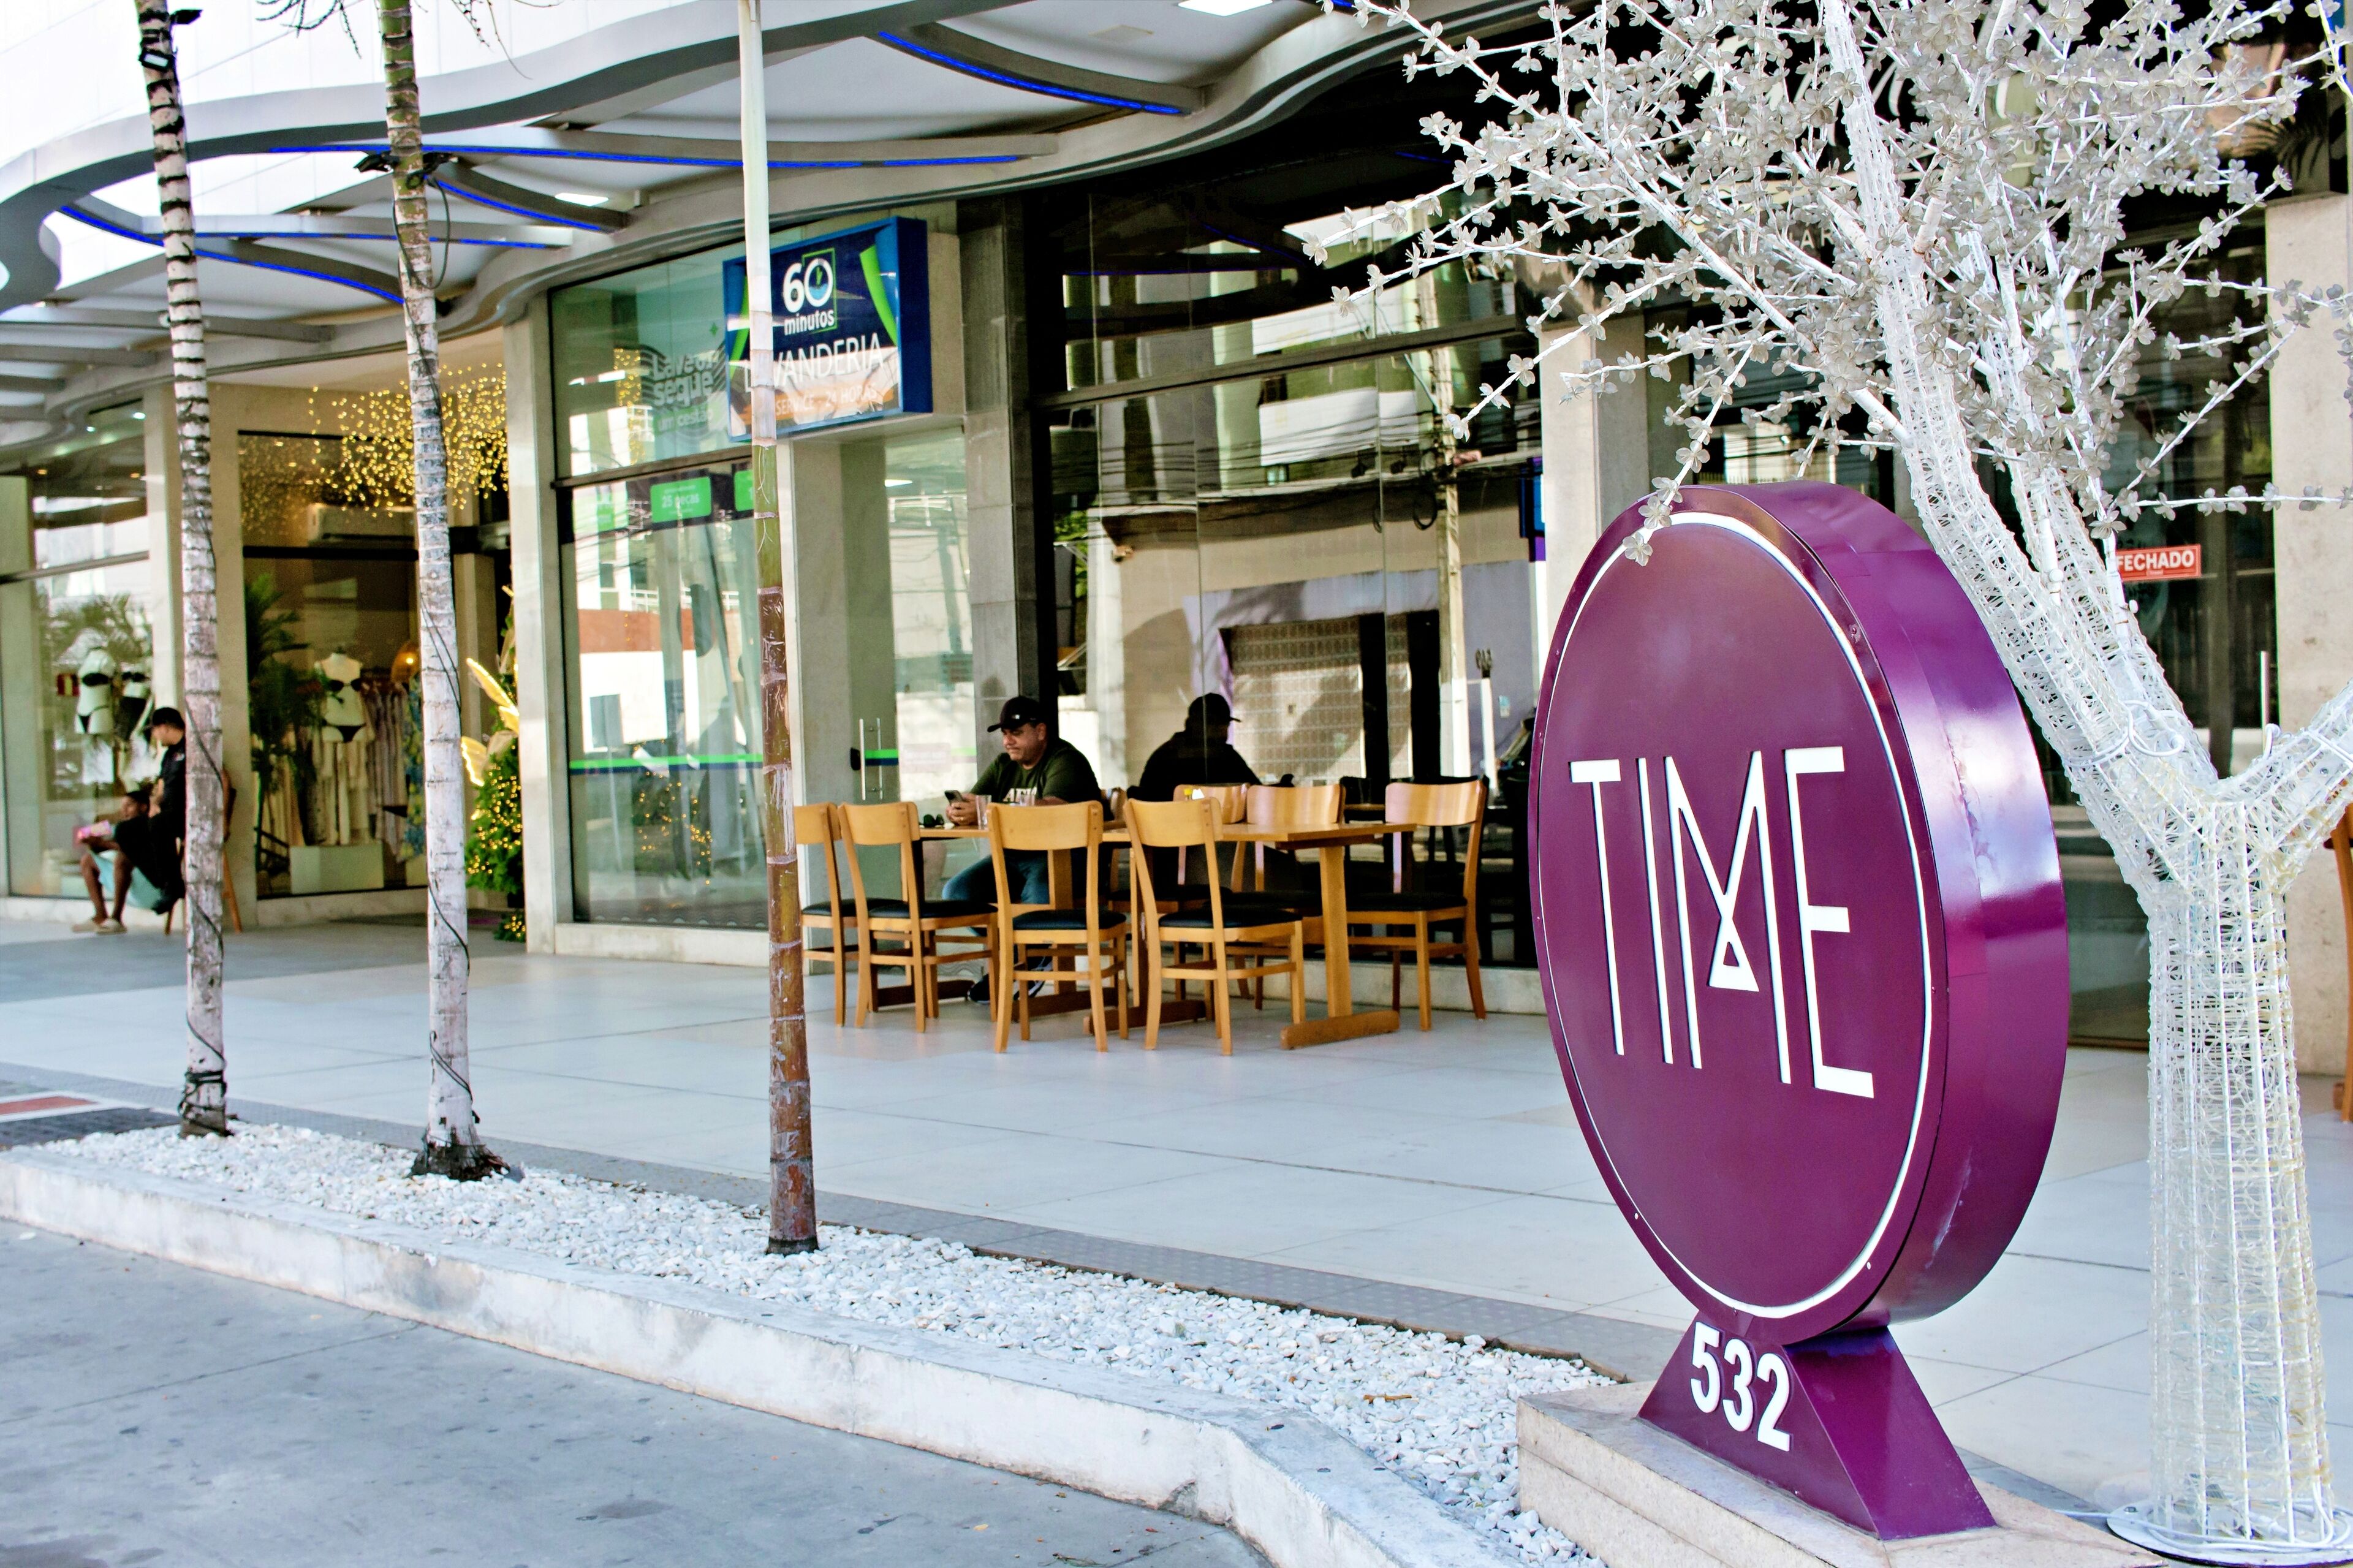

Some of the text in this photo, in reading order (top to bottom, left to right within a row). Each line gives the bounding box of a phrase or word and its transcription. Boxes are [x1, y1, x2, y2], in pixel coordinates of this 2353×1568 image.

[783, 258, 834, 313] 60
[784, 308, 835, 336] minutos
[745, 333, 884, 393] LVANDERIA
[653, 371, 714, 406] seque
[825, 391, 837, 407] 24
[2116, 550, 2195, 572] FECHADO
[1568, 746, 1874, 1098] TIME
[1690, 1322, 1790, 1452] 532
